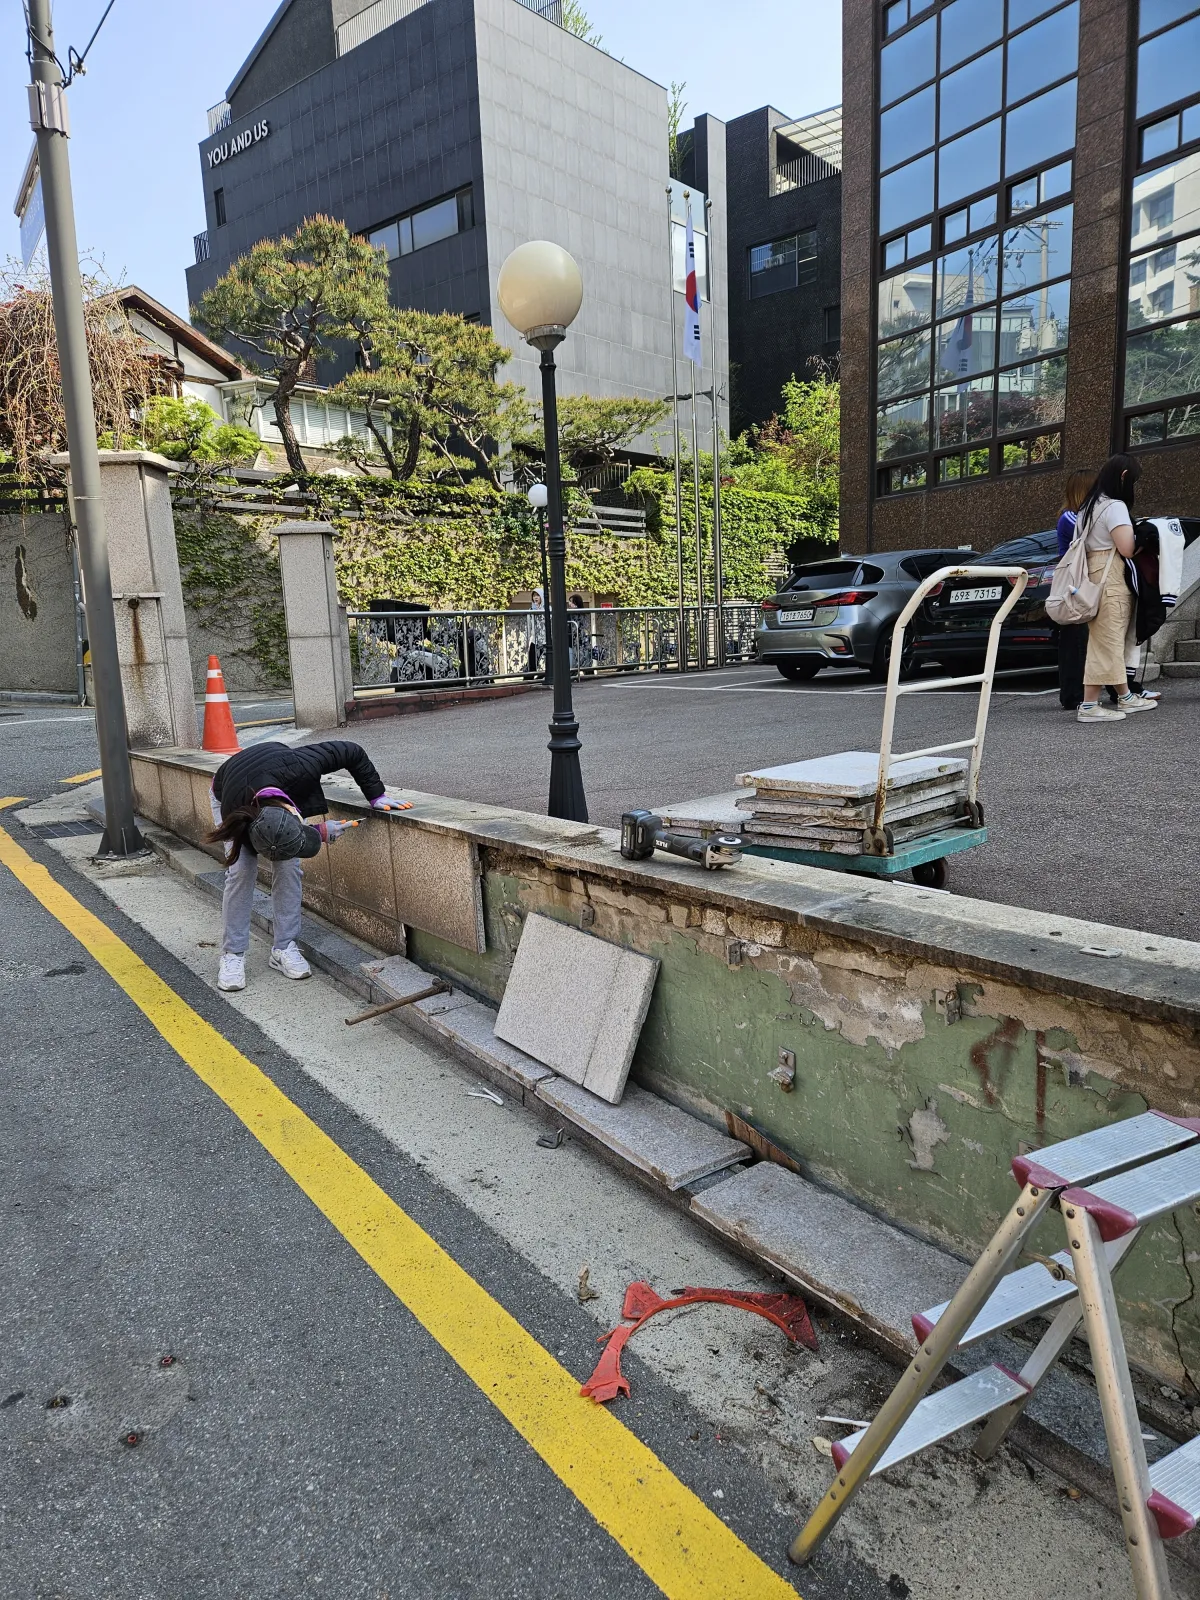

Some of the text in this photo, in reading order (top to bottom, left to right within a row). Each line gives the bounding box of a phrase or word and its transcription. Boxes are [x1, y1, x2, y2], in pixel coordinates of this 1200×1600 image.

[207, 119, 269, 168] YOU AND US
[974, 588, 997, 600] 7315
